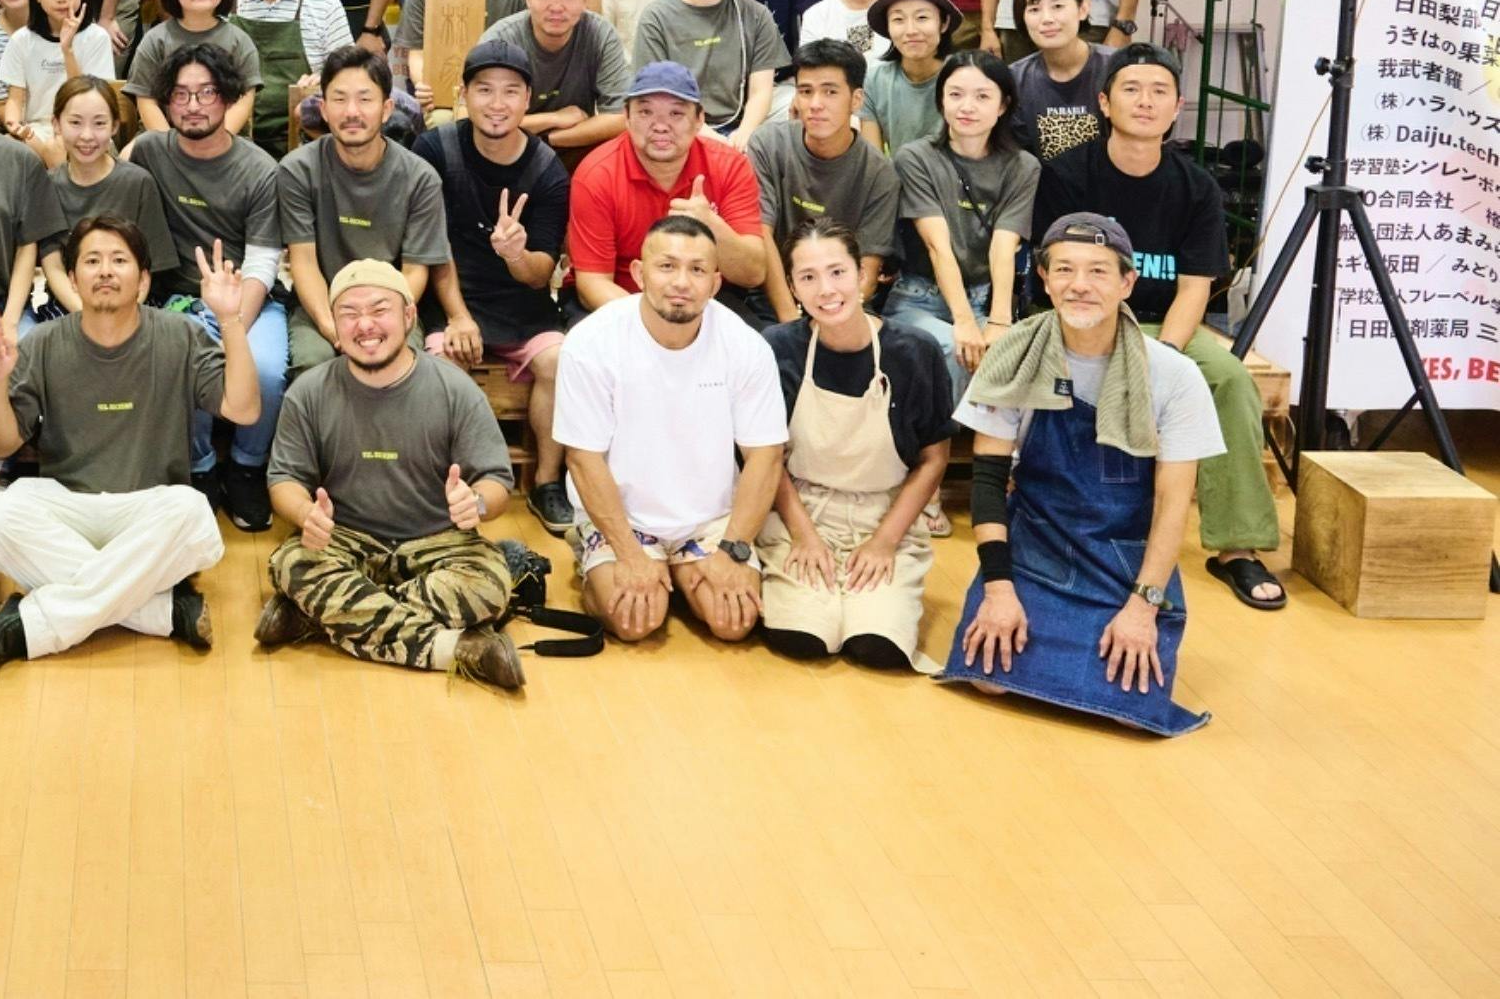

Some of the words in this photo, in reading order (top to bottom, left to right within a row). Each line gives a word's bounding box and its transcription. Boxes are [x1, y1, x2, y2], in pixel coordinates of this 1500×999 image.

[1377, 58, 1463, 92] 我武者羅
[1349, 318, 1469, 339] 日田剤薬局
